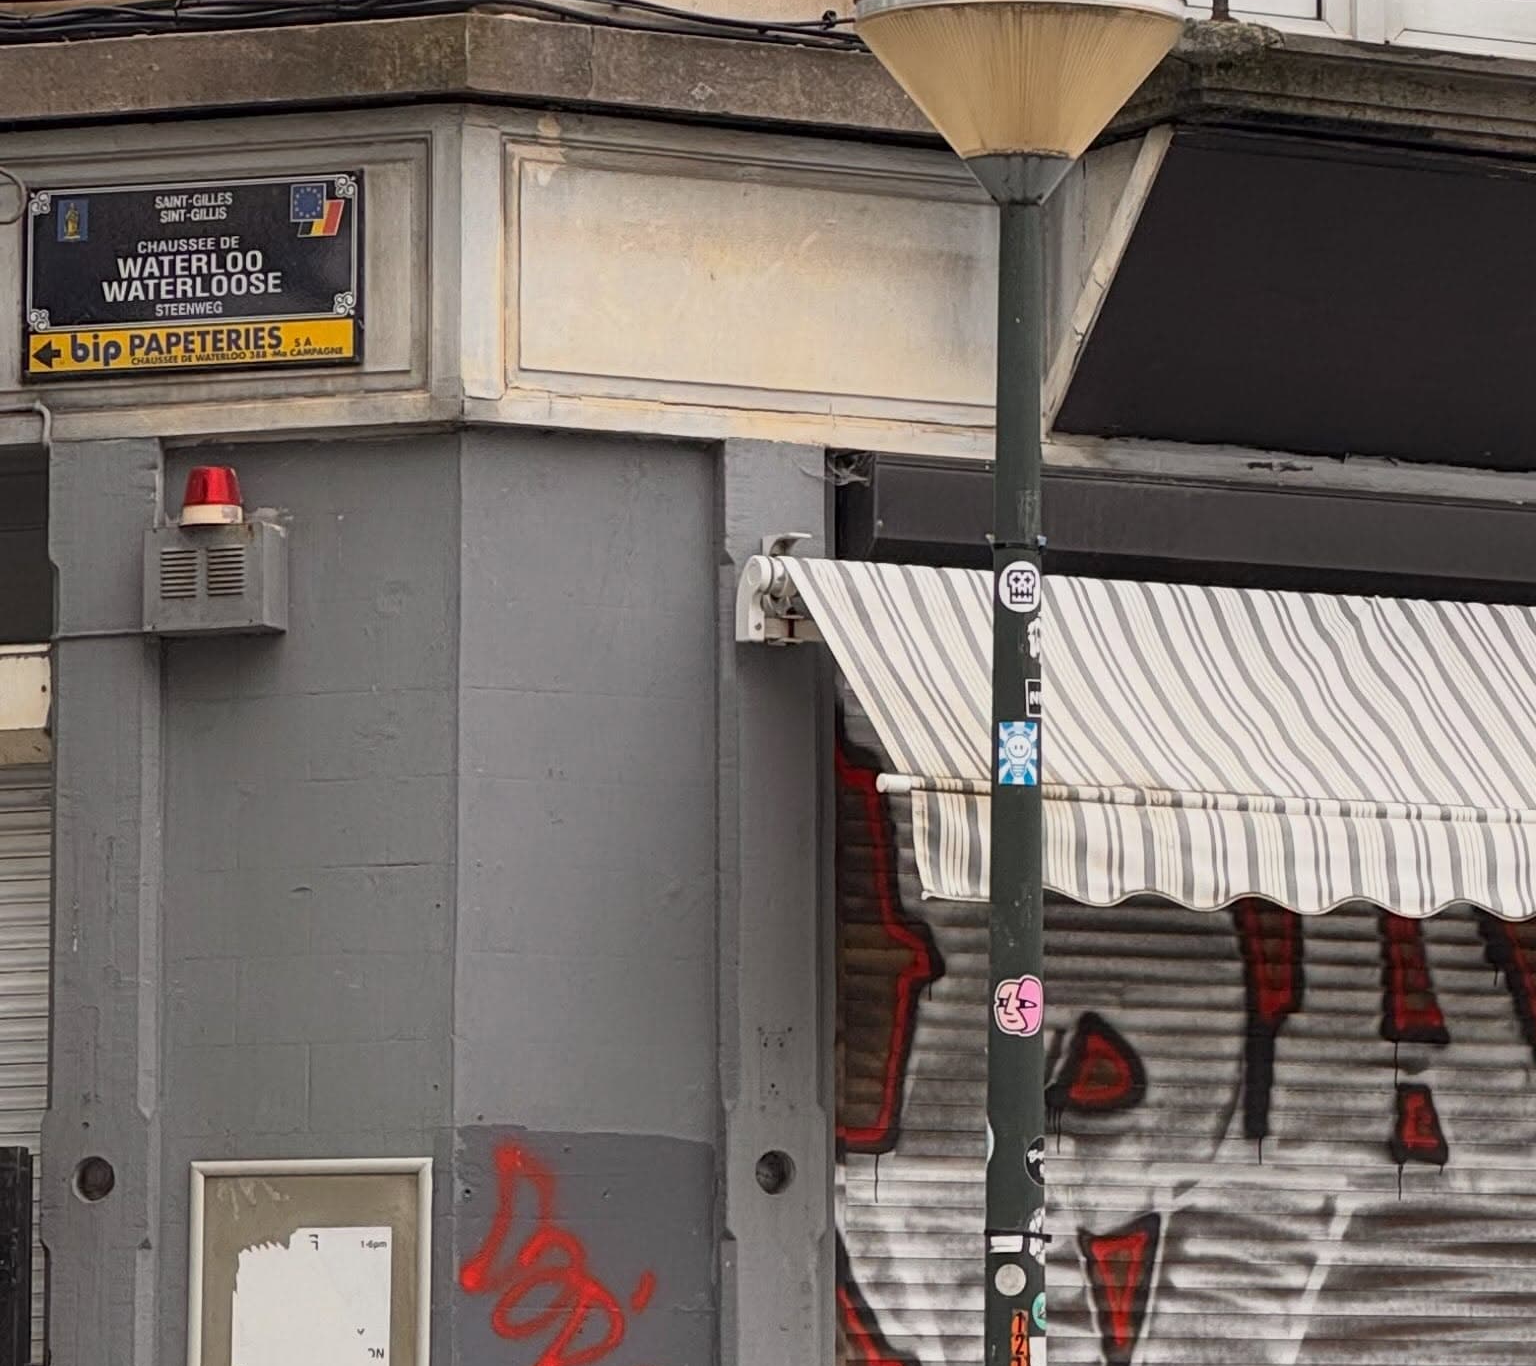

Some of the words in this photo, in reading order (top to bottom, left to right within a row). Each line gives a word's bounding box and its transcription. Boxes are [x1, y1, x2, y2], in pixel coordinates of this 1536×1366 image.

[155, 192, 233, 209] SAINT-GILLES
[160, 206, 227, 223] SINT-GILLIS
[137, 237, 216, 254] CHAUSSEE
[220, 235, 240, 250] DE
[117, 250, 262, 279] WATERLOO
[103, 272, 282, 302] WATERLOOSE
[155, 301, 223, 317] STEENWEG
[70, 334, 122, 367] bip
[129, 326, 282, 357] PAPETERIES
[131, 355, 178, 366] CHAUSSEE
[181, 353, 193, 363] DE
[195, 351, 246, 362] WATERLOO
[290, 346, 344, 357] CAMPAGNE
